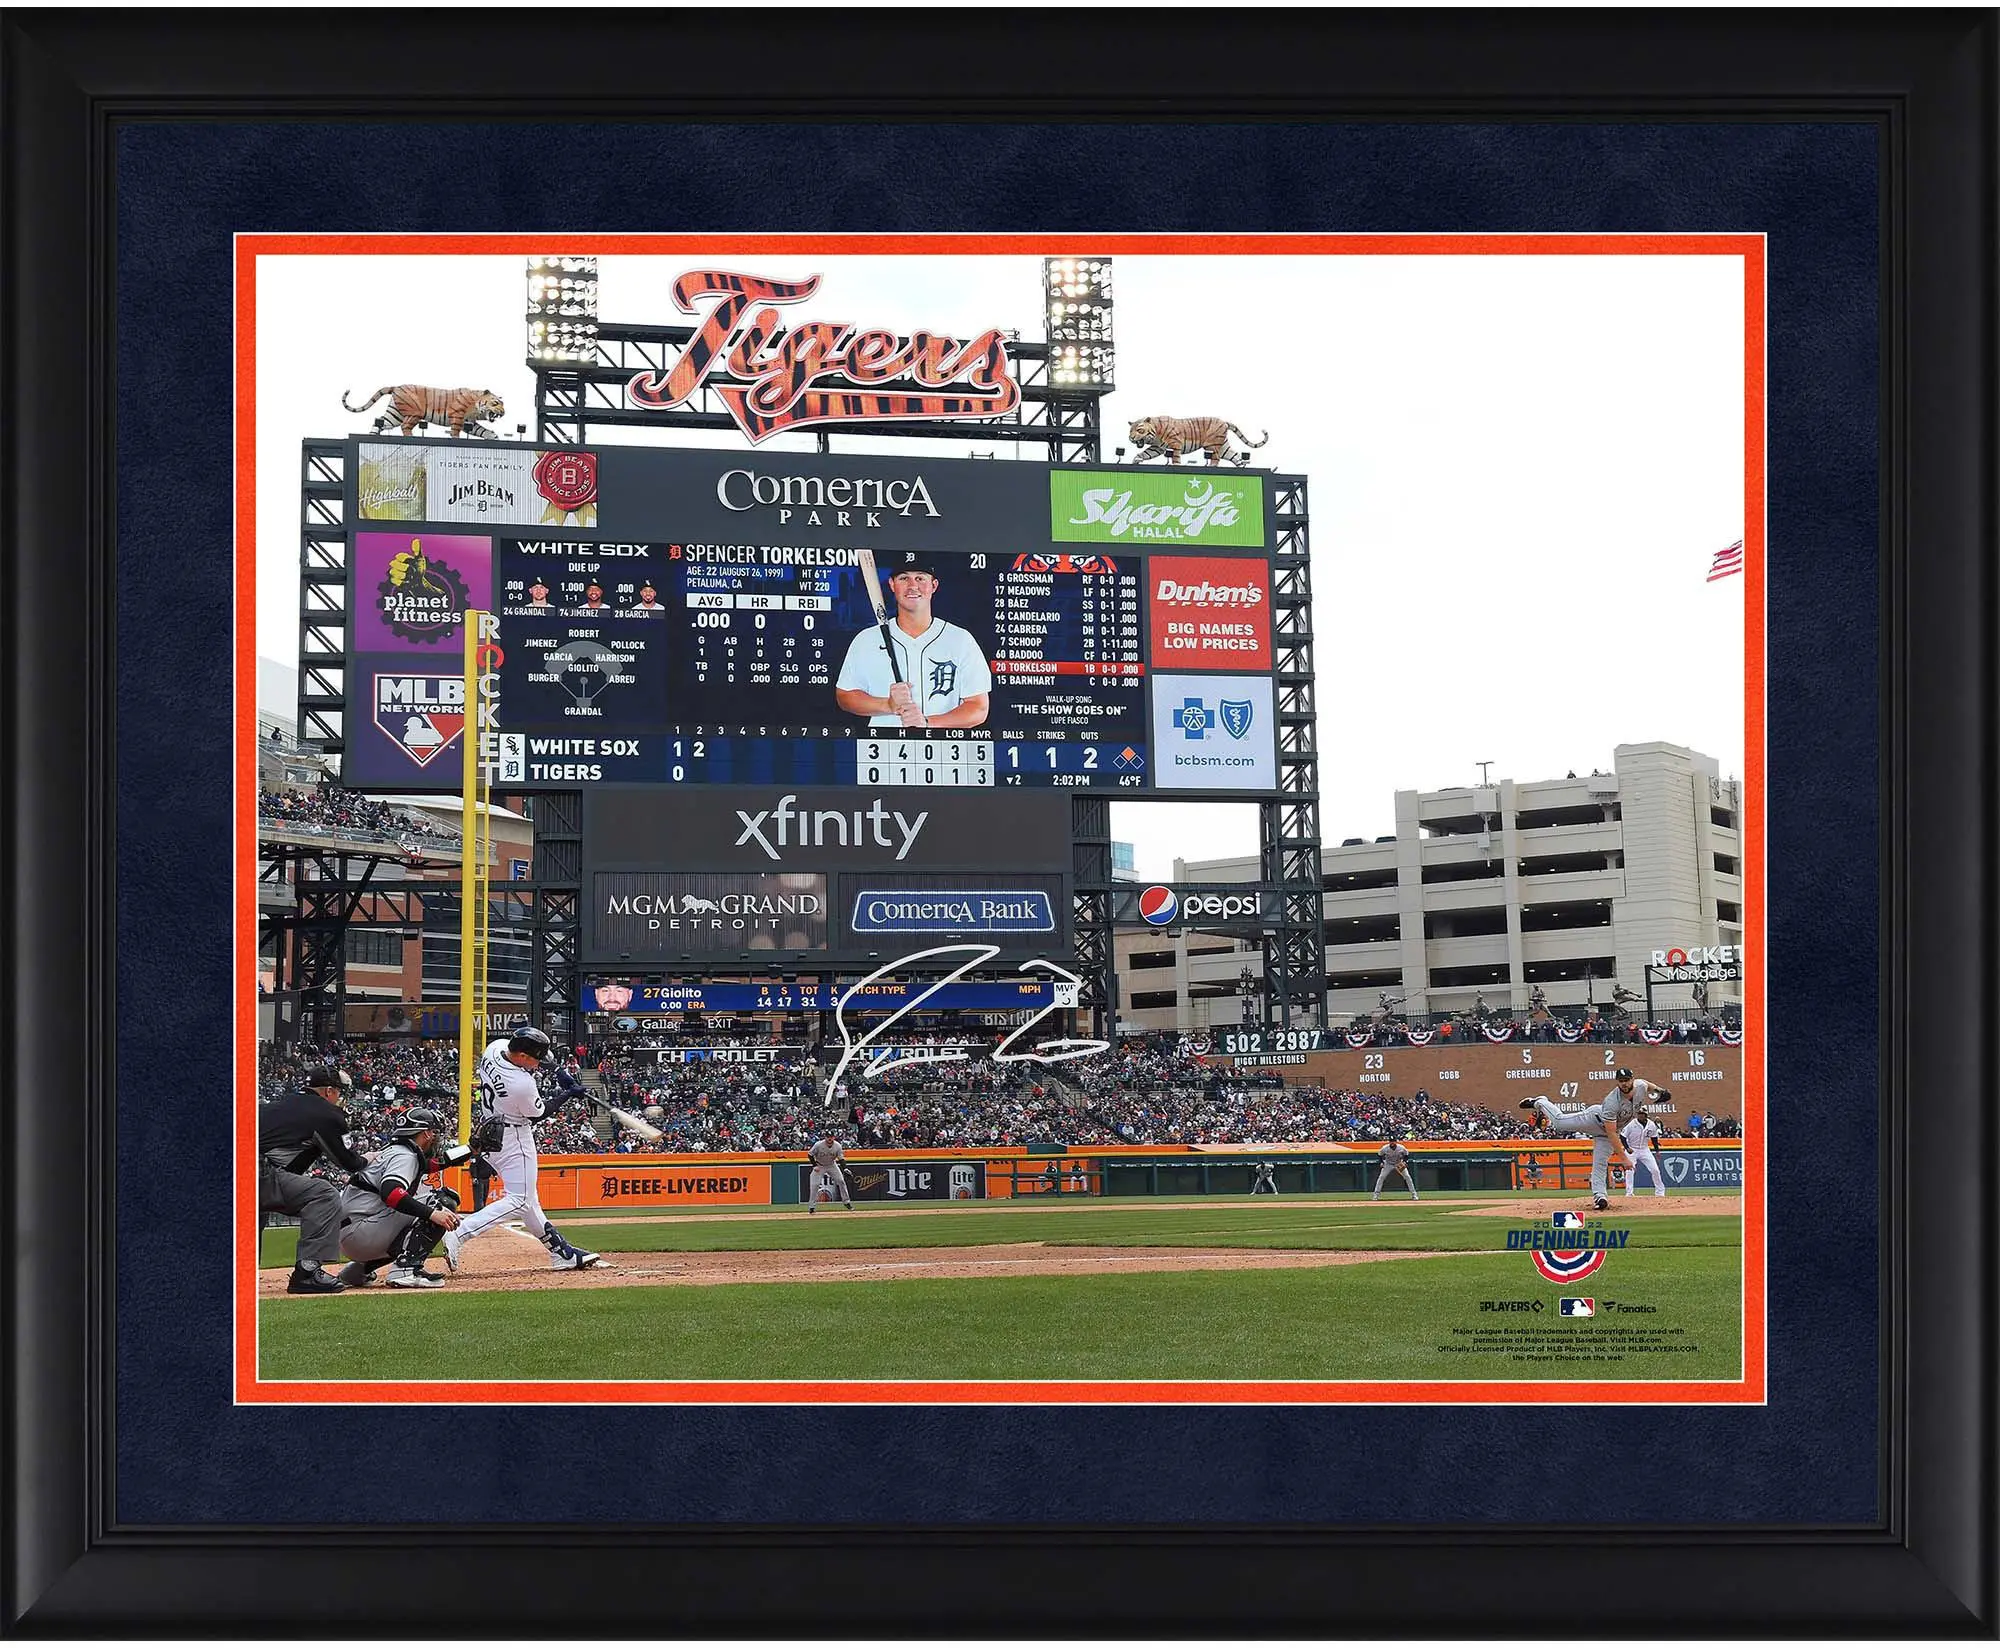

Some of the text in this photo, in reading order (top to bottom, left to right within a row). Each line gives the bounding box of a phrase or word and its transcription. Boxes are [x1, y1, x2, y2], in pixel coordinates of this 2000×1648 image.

[627, 267, 1021, 446] Tigers
[448, 479, 514, 507] JIM BEAM
[1069, 484, 1240, 537] Sharifa
[780, 508, 881, 528] PARK
[1132, 527, 1184, 539] HALAL
[517, 541, 649, 557] WHITE SOX
[686, 544, 859, 567] SPENCER TORKELSON
[568, 562, 600, 573] DUE UP
[706, 566, 717, 577] 22
[1006, 573, 1054, 583] GROSSMAN
[731, 579, 743, 589] CA
[1007, 587, 1051, 596] MEADOWS
[1157, 580, 1263, 603] Dunham's
[384, 593, 449, 611] planet
[697, 596, 819, 609] AVG HR RBI
[393, 607, 462, 624] fitness
[514, 607, 546, 616] GRANDAL
[569, 609, 599, 618] JIMENEZ
[624, 610, 650, 619] GARCIA
[1007, 612, 1061, 622] CANDELARIO
[568, 629, 600, 638] ROBERT
[1007, 624, 1048, 634] CABRERA
[1167, 622, 1254, 636] BIG NAMES
[524, 639, 558, 648] JIMENEZ
[611, 640, 646, 650] POLLOCK
[1008, 637, 1042, 647] SCHOOP
[1164, 637, 1259, 651] LOW PRICES
[543, 653, 573, 662] GARCIA
[595, 653, 635, 663] HARRISON
[1009, 650, 1043, 660] BADDOO
[568, 663, 599, 673] GIOLITO
[1009, 663, 1058, 673] TORKELSON
[528, 673, 560, 683] BURGER
[608, 675, 636, 684] ABREU
[1009, 675, 1056, 686] BARNHART
[379, 678, 465, 704] MLB
[1045, 695, 1093, 704] WALK-UP SONG
[380, 704, 465, 714] NETWORK
[564, 707, 603, 716] GRANDAL
[1040, 705, 1073, 715] SHOW
[1075, 705, 1104, 715] GOES
[1051, 716, 1089, 725] LUPE FIASCO
[1002, 730, 1099, 741] BALLS STRIKES OUTS
[529, 739, 640, 757] WHITE SOX
[1175, 754, 1255, 767] bcbsm.com
[530, 763, 602, 780] TIGERS
[1052, 775, 1090, 787] 2:02 PM
[734, 795, 929, 860] xfinity
[606, 894, 817, 916] MGM GRAND
[980, 898, 1039, 920] Bank
[1183, 892, 1262, 920] pepsi
[648, 918, 781, 931] DETROIT
[1667, 967, 1737, 981] Mortgage
[643, 988, 660, 999] 27
[881, 986, 907, 995] TYPE
[1018, 985, 1041, 994] MPH
[660, 1001, 706, 1010] 0.00 ERA
[641, 1018, 732, 1032] Gallag EXIT
[1226, 1033, 1261, 1053] 502
[1276, 1030, 1321, 1051] 2987
[1259, 1054, 1306, 1065] MILESTONES
[1365, 1054, 1384, 1070] 23
[1688, 1050, 1705, 1066] 16
[1359, 1072, 1391, 1083] HORTON
[1439, 1070, 1460, 1080] COBB
[1506, 1068, 1551, 1079] GREENBERG
[1588, 1069, 1617, 1081] GEHRIN
[1672, 1070, 1724, 1081] NEWHOUSER
[1560, 1082, 1579, 1098] 47
[886, 1168, 932, 1197] Lite
